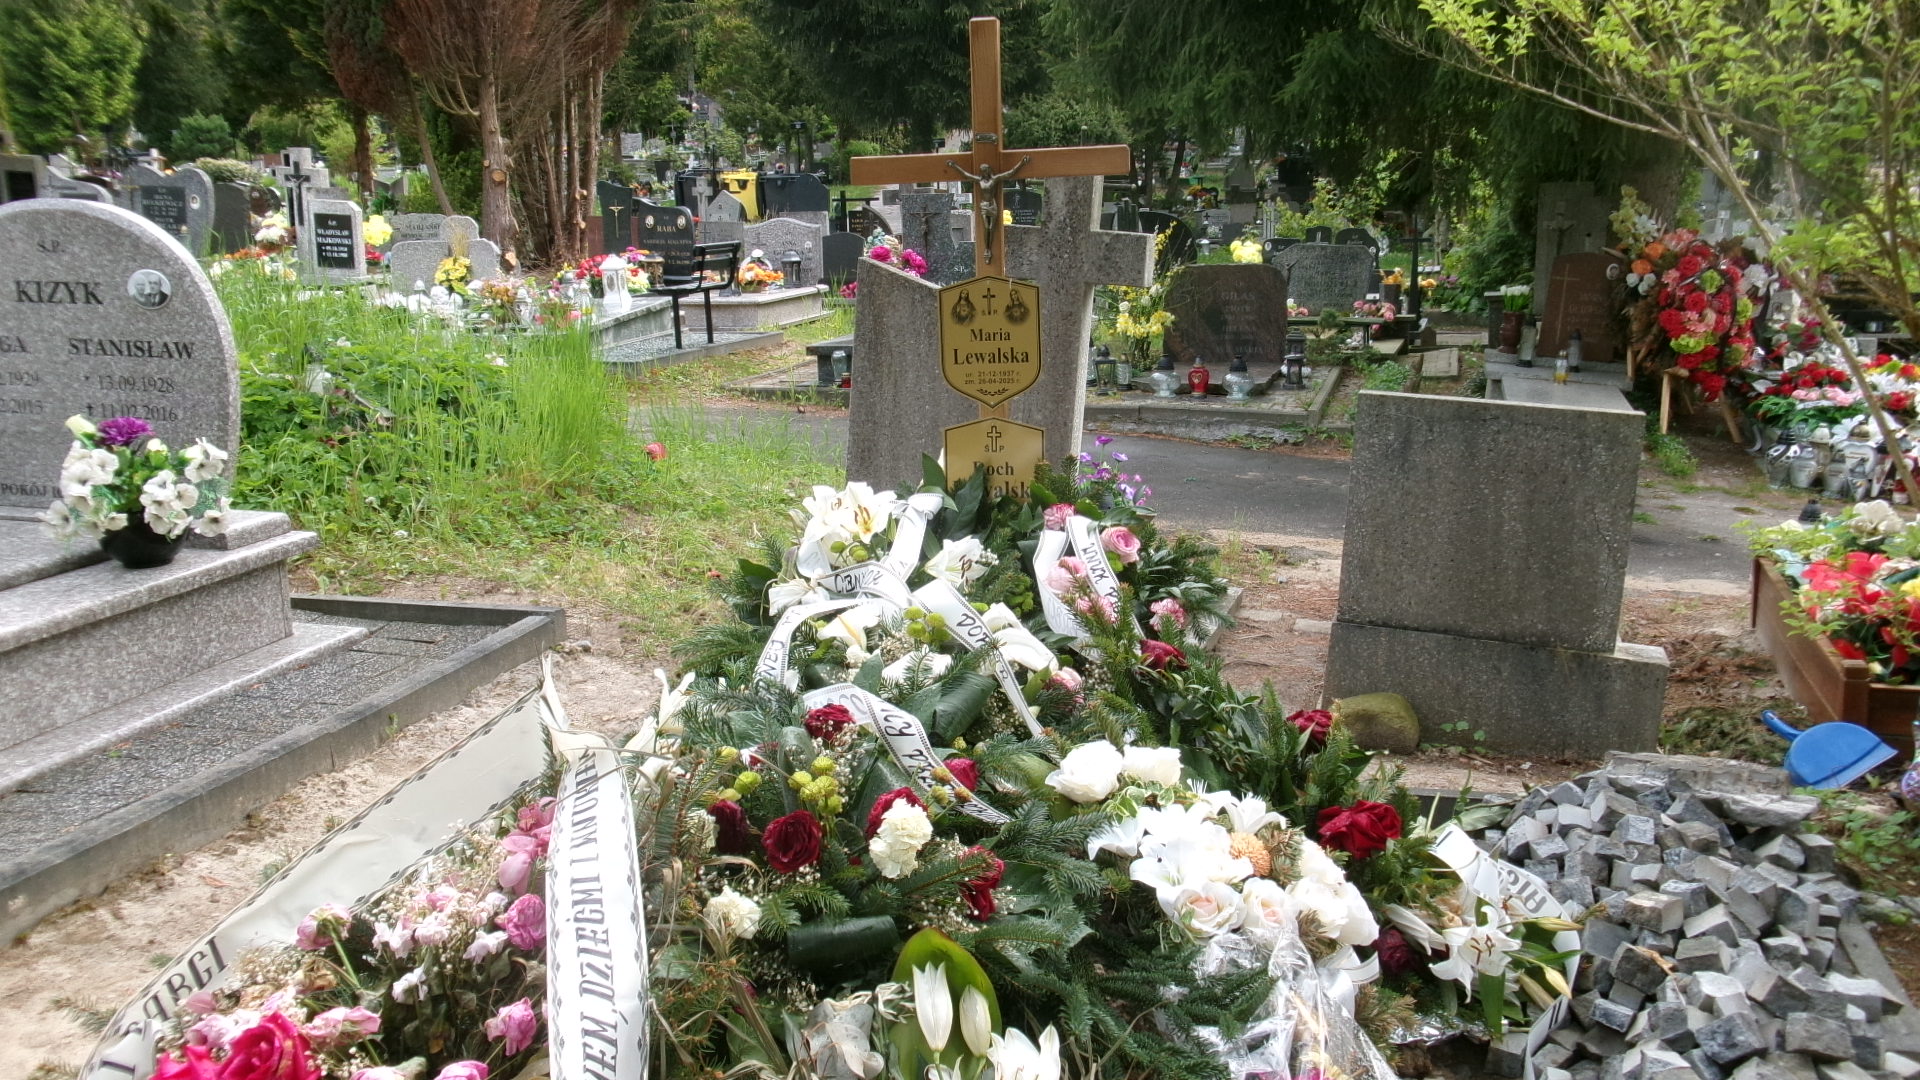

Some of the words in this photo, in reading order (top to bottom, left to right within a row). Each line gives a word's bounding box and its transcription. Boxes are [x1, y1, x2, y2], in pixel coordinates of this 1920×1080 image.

[15, 280, 104, 305] KIZYK
[970, 327, 1012, 342] Maria
[68, 337, 195, 360] STANISŁAW
[953, 346, 1030, 366] Lewalska
[98, 375, 175, 394] 13.09.1928
[999, 445, 1005, 453] P
